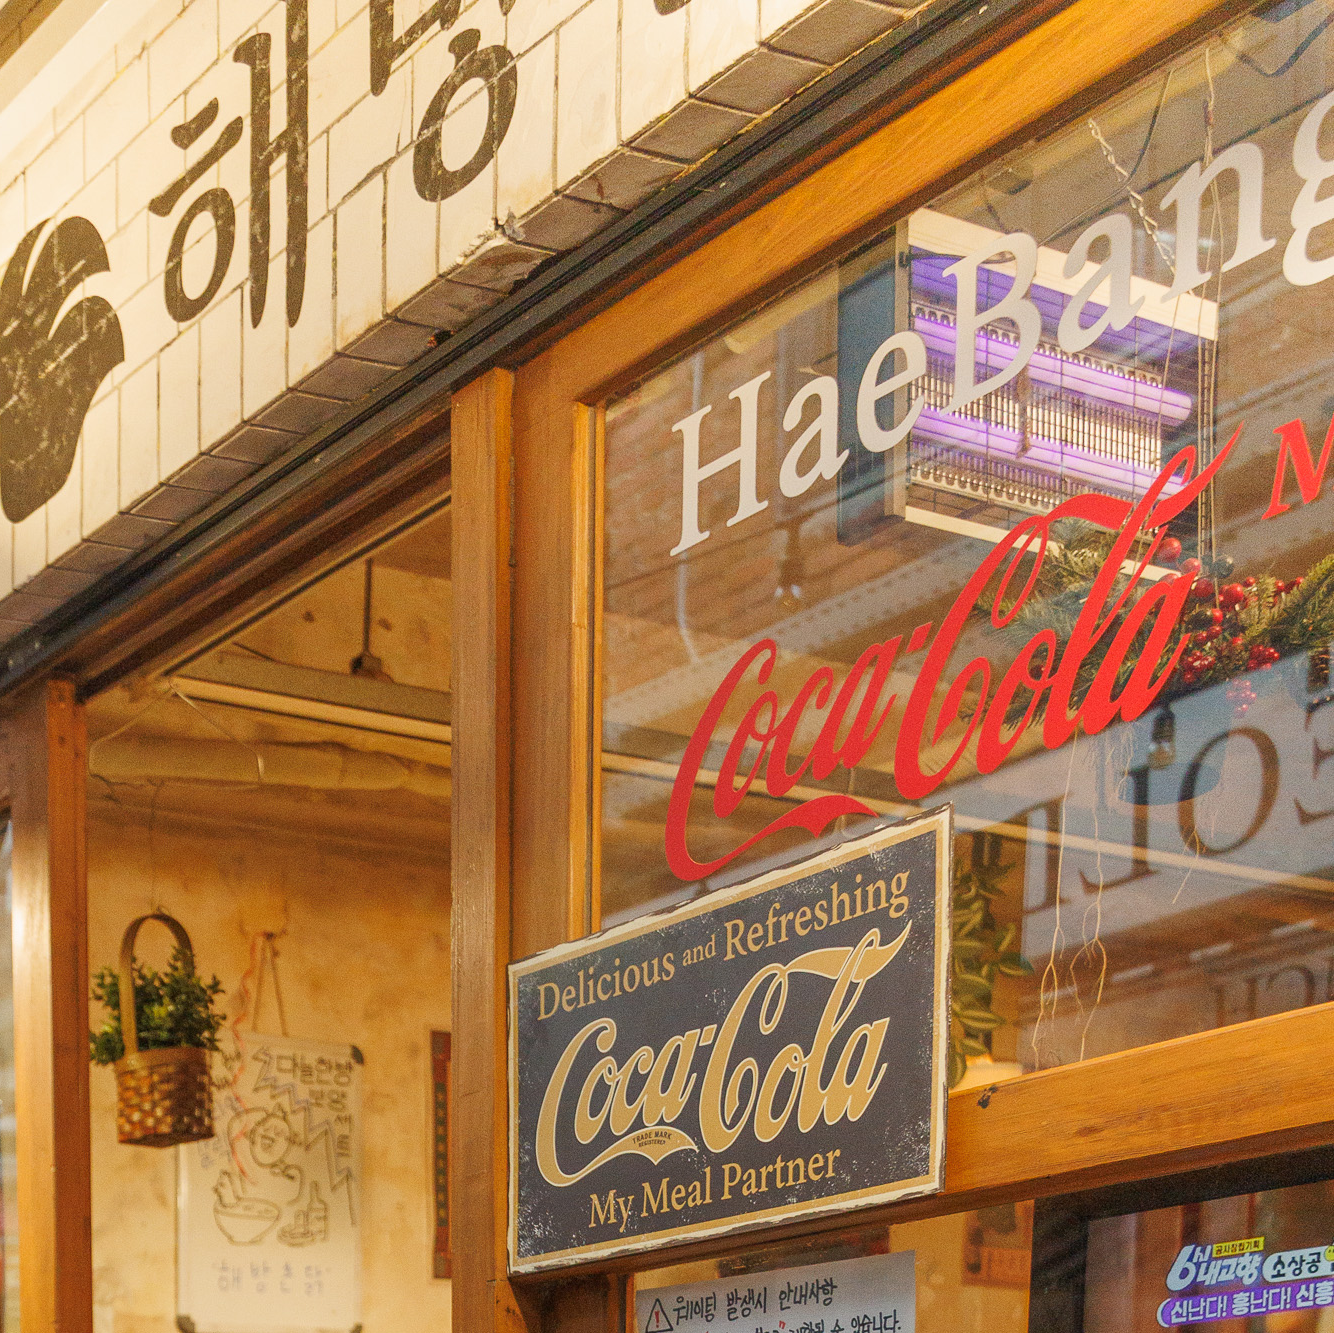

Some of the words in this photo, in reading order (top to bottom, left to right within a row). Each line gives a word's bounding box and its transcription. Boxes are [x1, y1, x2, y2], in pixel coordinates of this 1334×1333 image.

[664, 420, 1245, 881] Coca-Cola
[537, 952, 675, 1021] Delicious
[682, 935, 717, 967] and
[723, 868, 911, 961] Refreshing
[536, 919, 913, 1187] Coca-Cola
[632, 1131, 653, 1145] TRADE
[654, 1129, 673, 1140] MARK
[588, 1189, 634, 1234] My
[640, 1165, 713, 1218] Meal
[721, 1149, 842, 1202] Partner
[726, 1285, 767, 1322] 발생시
[778, 1277, 838, 1311] 안내사항
[1170, 1295, 1218, 1325] 신난다!
[1231, 1286, 1292, 1316] 흥난다!
